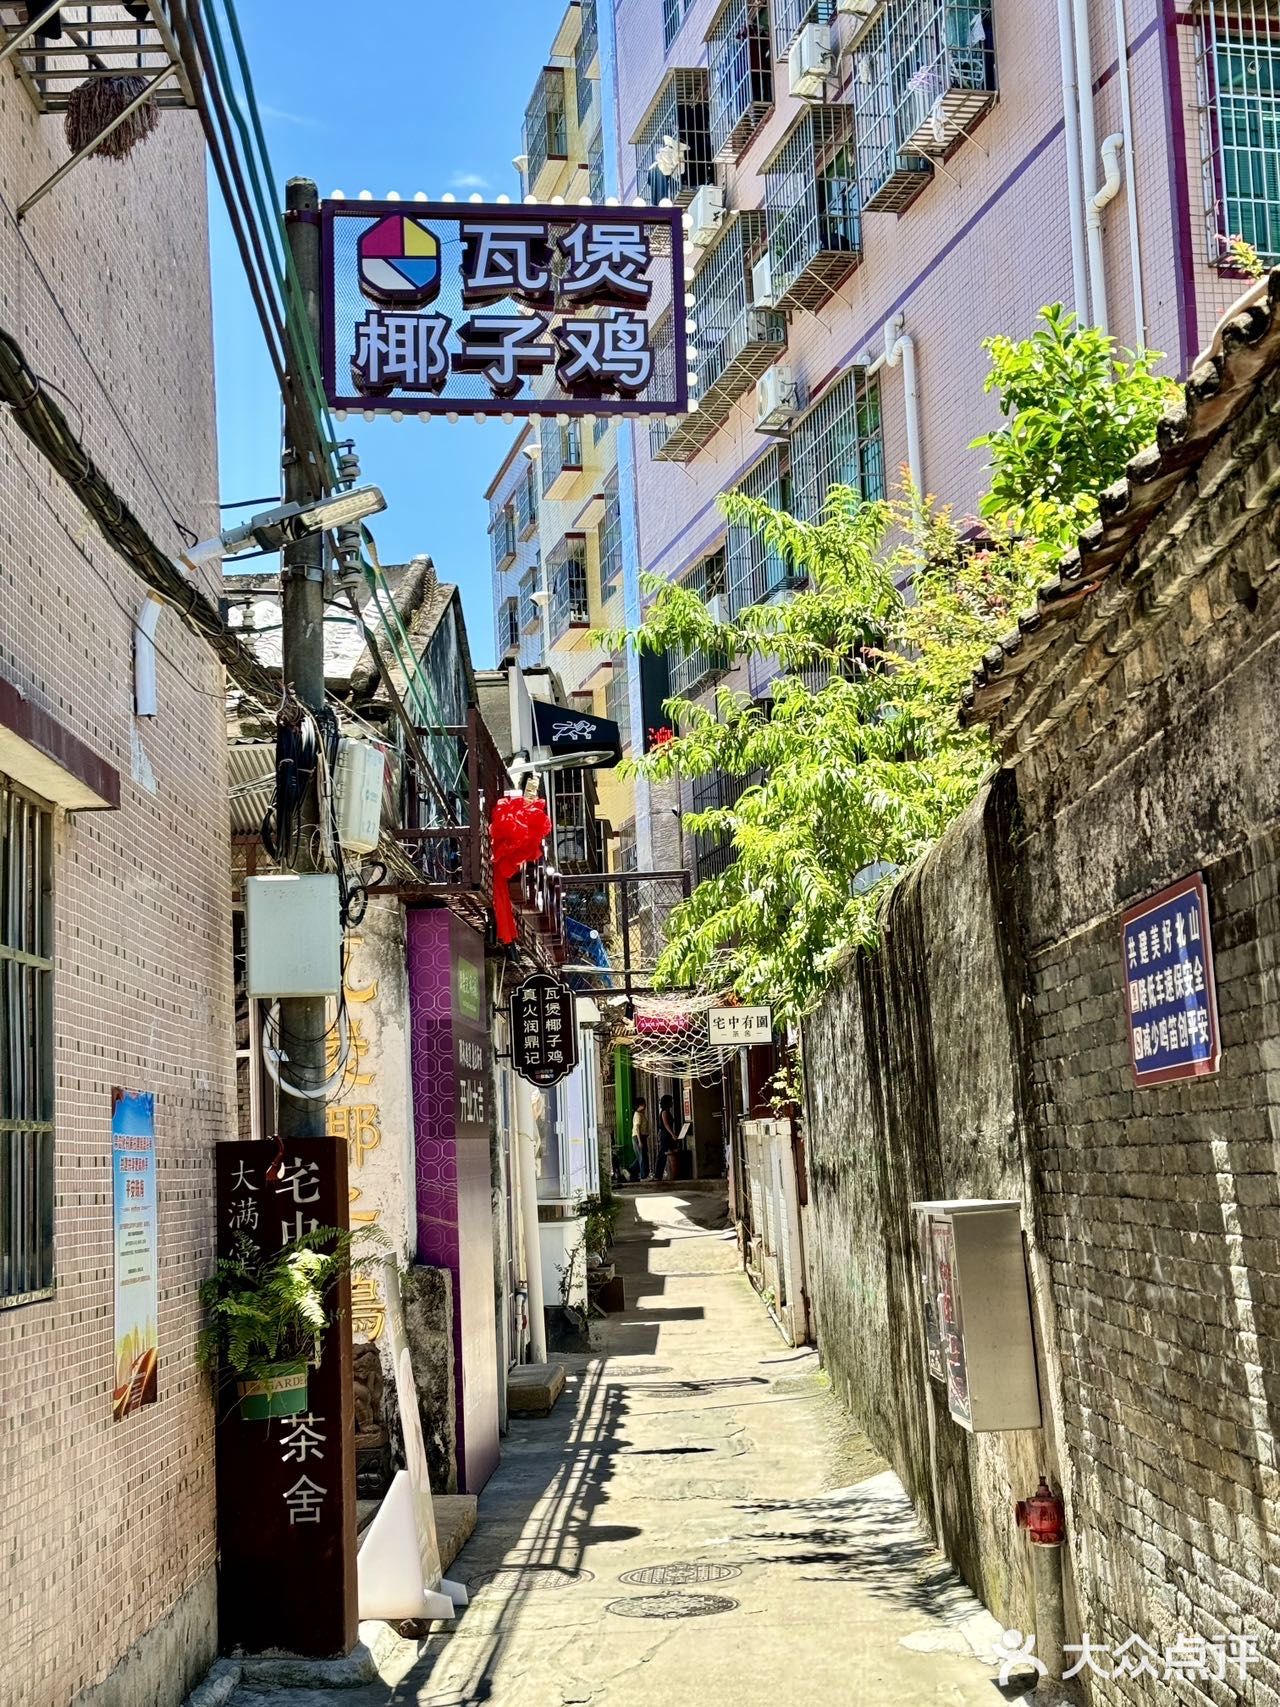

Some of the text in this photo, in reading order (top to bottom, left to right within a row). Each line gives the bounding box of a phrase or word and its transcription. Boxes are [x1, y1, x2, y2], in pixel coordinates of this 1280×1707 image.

[462, 221, 650, 293] 瓦煲
[356, 312, 655, 386] 椰子鸡
[1127, 905, 1201, 970] 共建美好北山
[1138, 955, 1205, 1012] 降低车速保安全
[521, 988, 541, 1065] 真火润鼎记
[544, 986, 564, 1064] 瓦煲椰子鸡
[1142, 1006, 1209, 1057] 减少鸣笛创平安
[459, 1078, 485, 1123] 开业大吉
